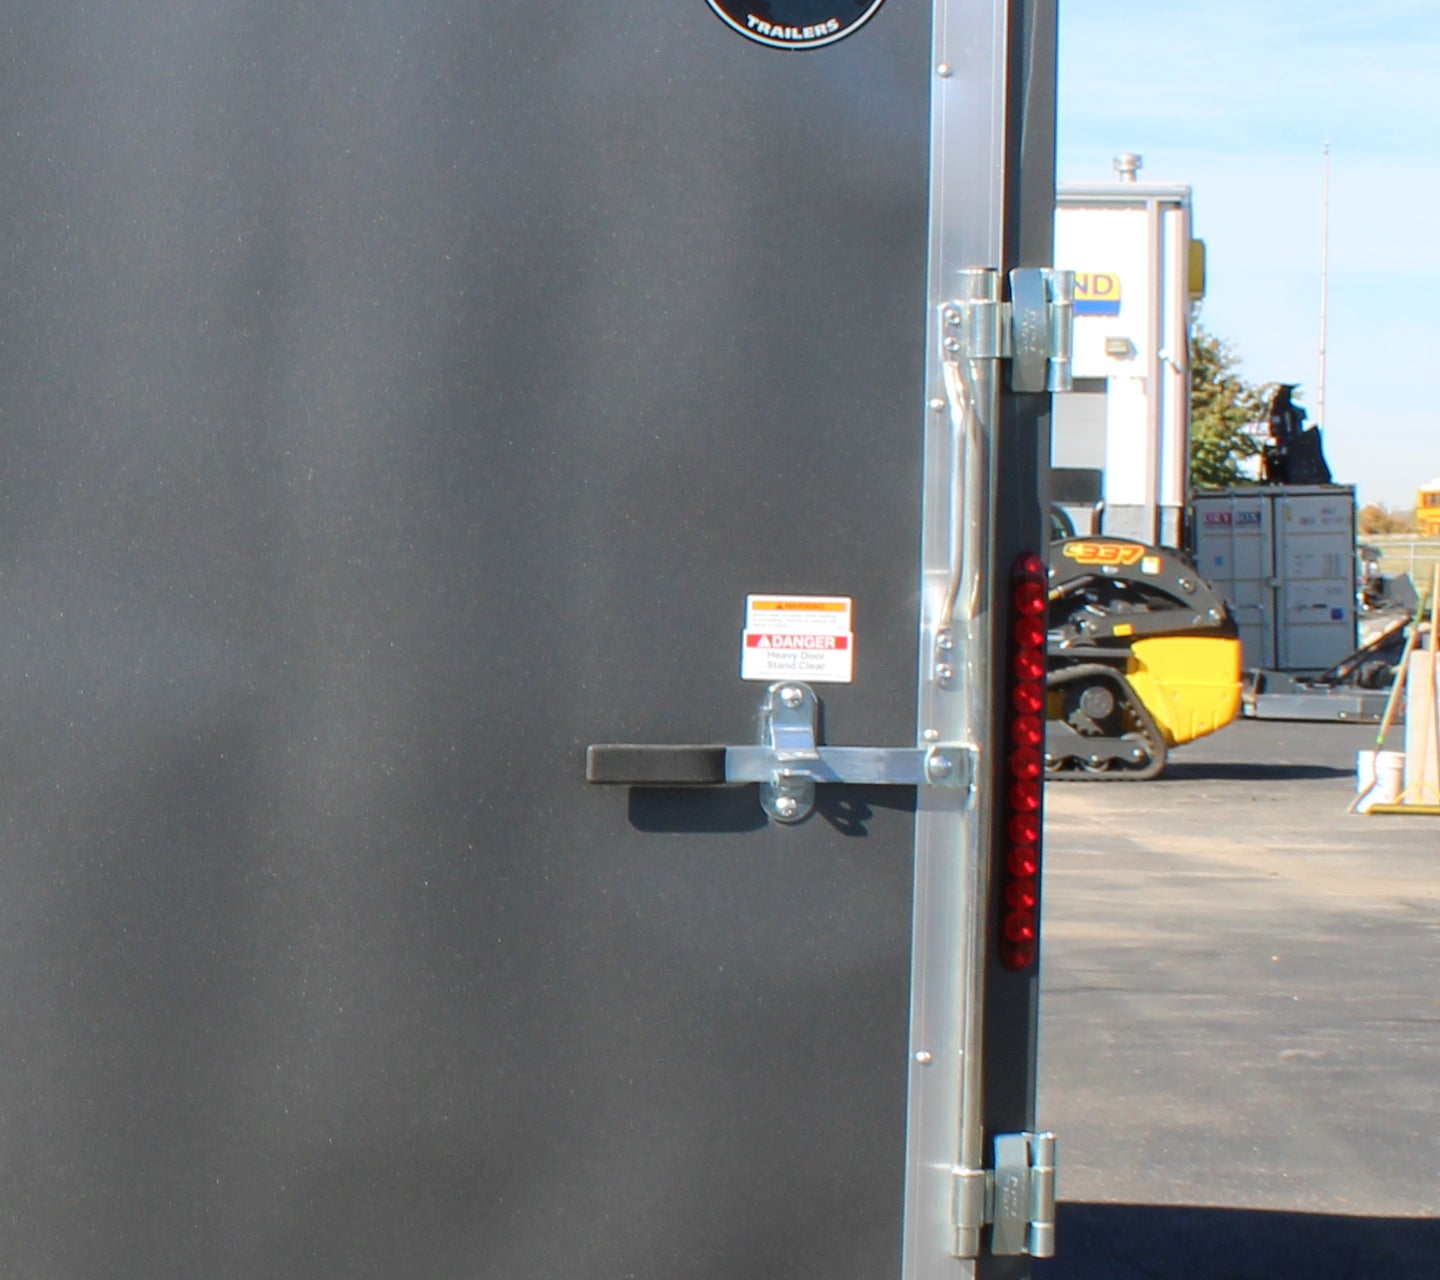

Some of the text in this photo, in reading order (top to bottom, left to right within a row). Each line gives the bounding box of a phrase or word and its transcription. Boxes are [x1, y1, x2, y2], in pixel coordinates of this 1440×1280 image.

[746, 13, 840, 40] TRAILERS
[772, 636, 836, 649] DANGER
[767, 651, 825, 662] Heavy Door
[766, 661, 825, 671] Stand Clear
